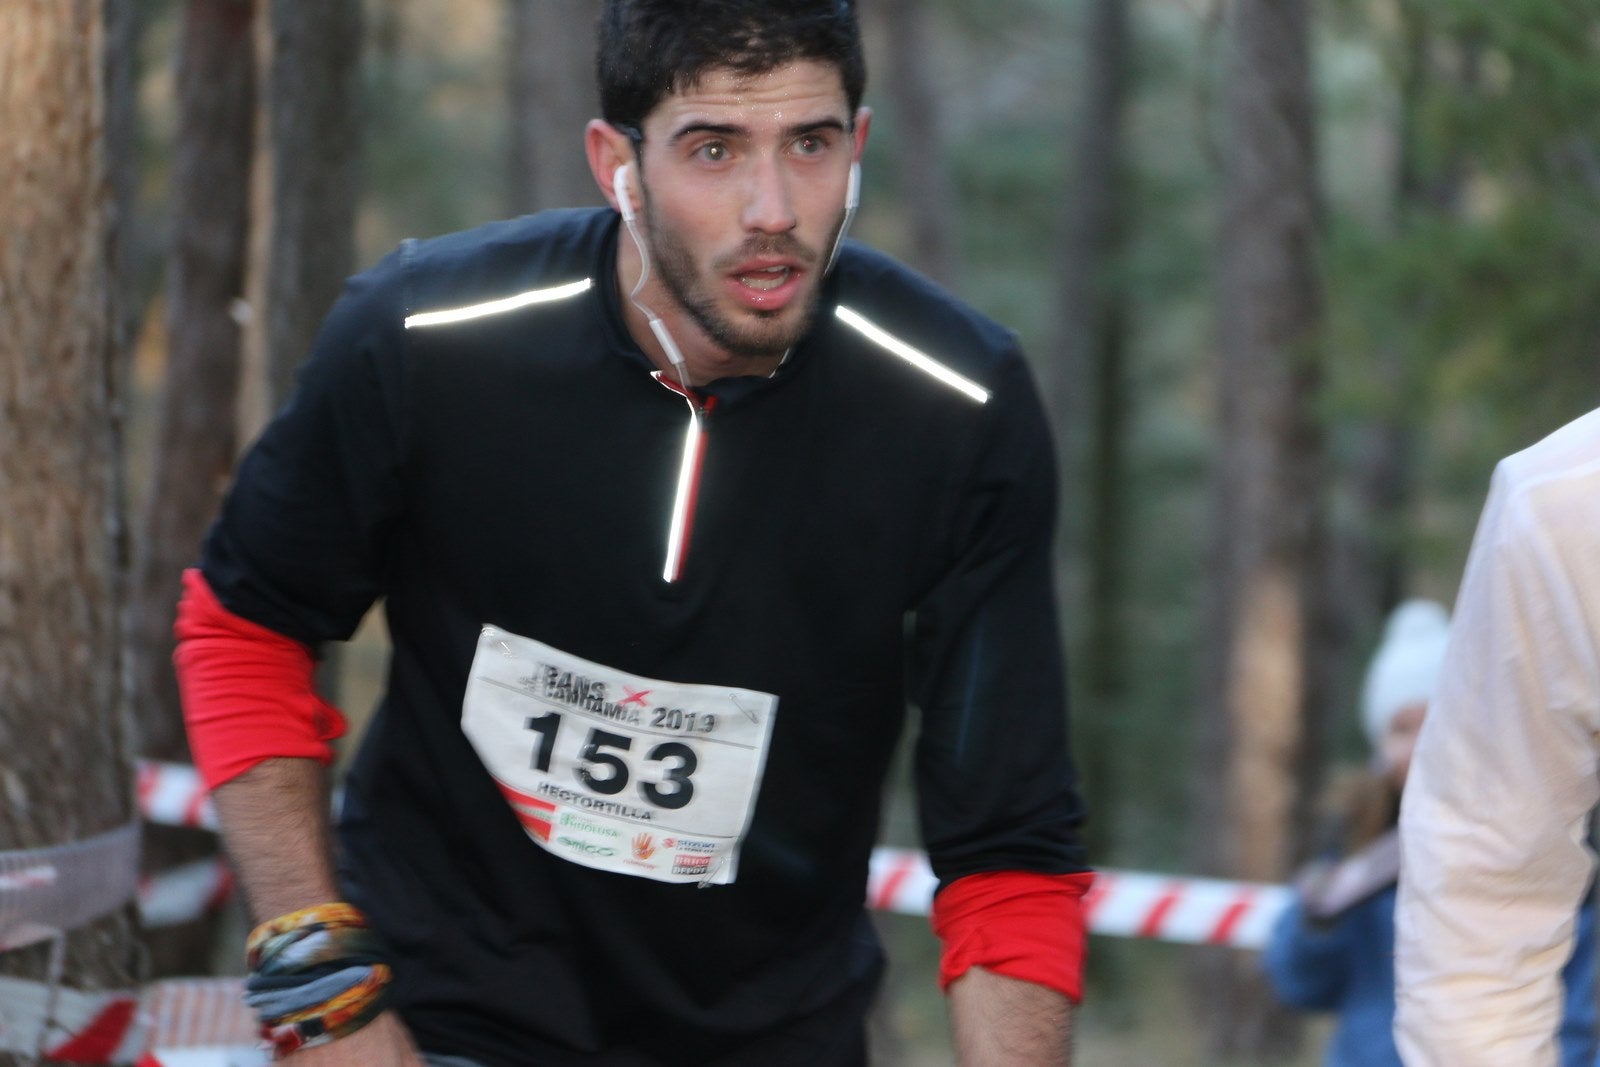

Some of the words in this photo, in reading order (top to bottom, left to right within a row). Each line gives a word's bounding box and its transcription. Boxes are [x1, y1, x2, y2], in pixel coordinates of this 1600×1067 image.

[649, 706, 717, 734] 2019
[524, 711, 698, 810] 153
[537, 782, 652, 820] HECTORTILLA
